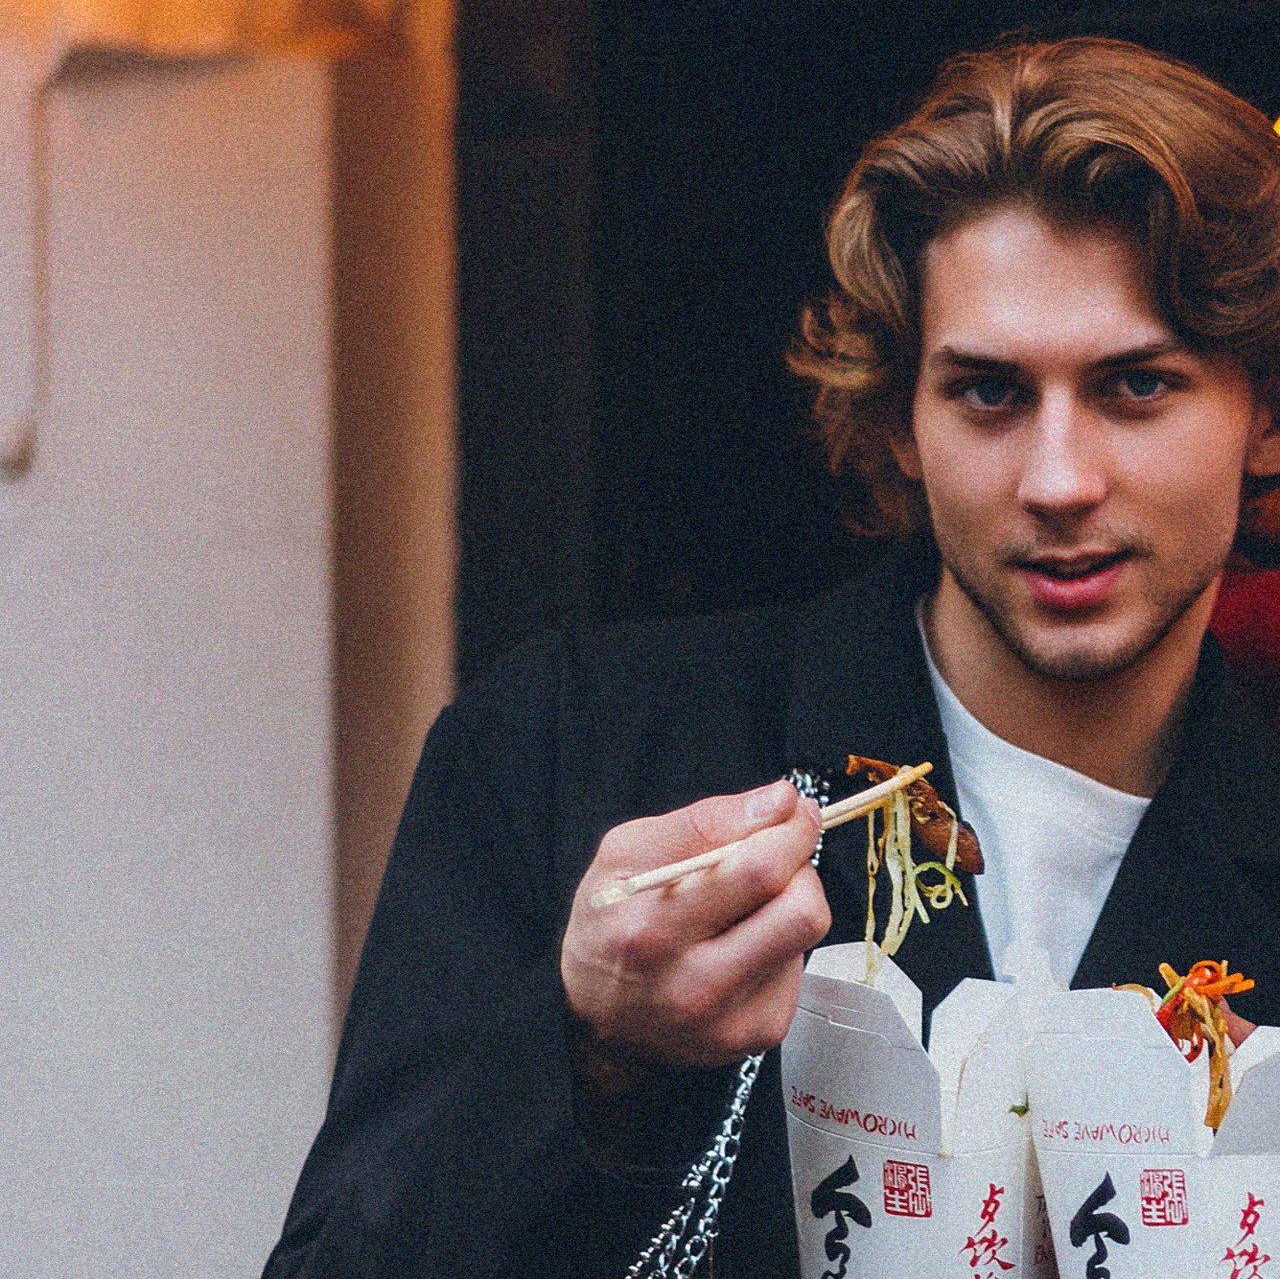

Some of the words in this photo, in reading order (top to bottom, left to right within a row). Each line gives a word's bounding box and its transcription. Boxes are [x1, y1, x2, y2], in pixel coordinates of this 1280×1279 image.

[820, 1098, 917, 1140] MICROWAVE
[1042, 1119, 1069, 1140] SAFE
[1074, 1121, 1170, 1144] MICROWAVE
